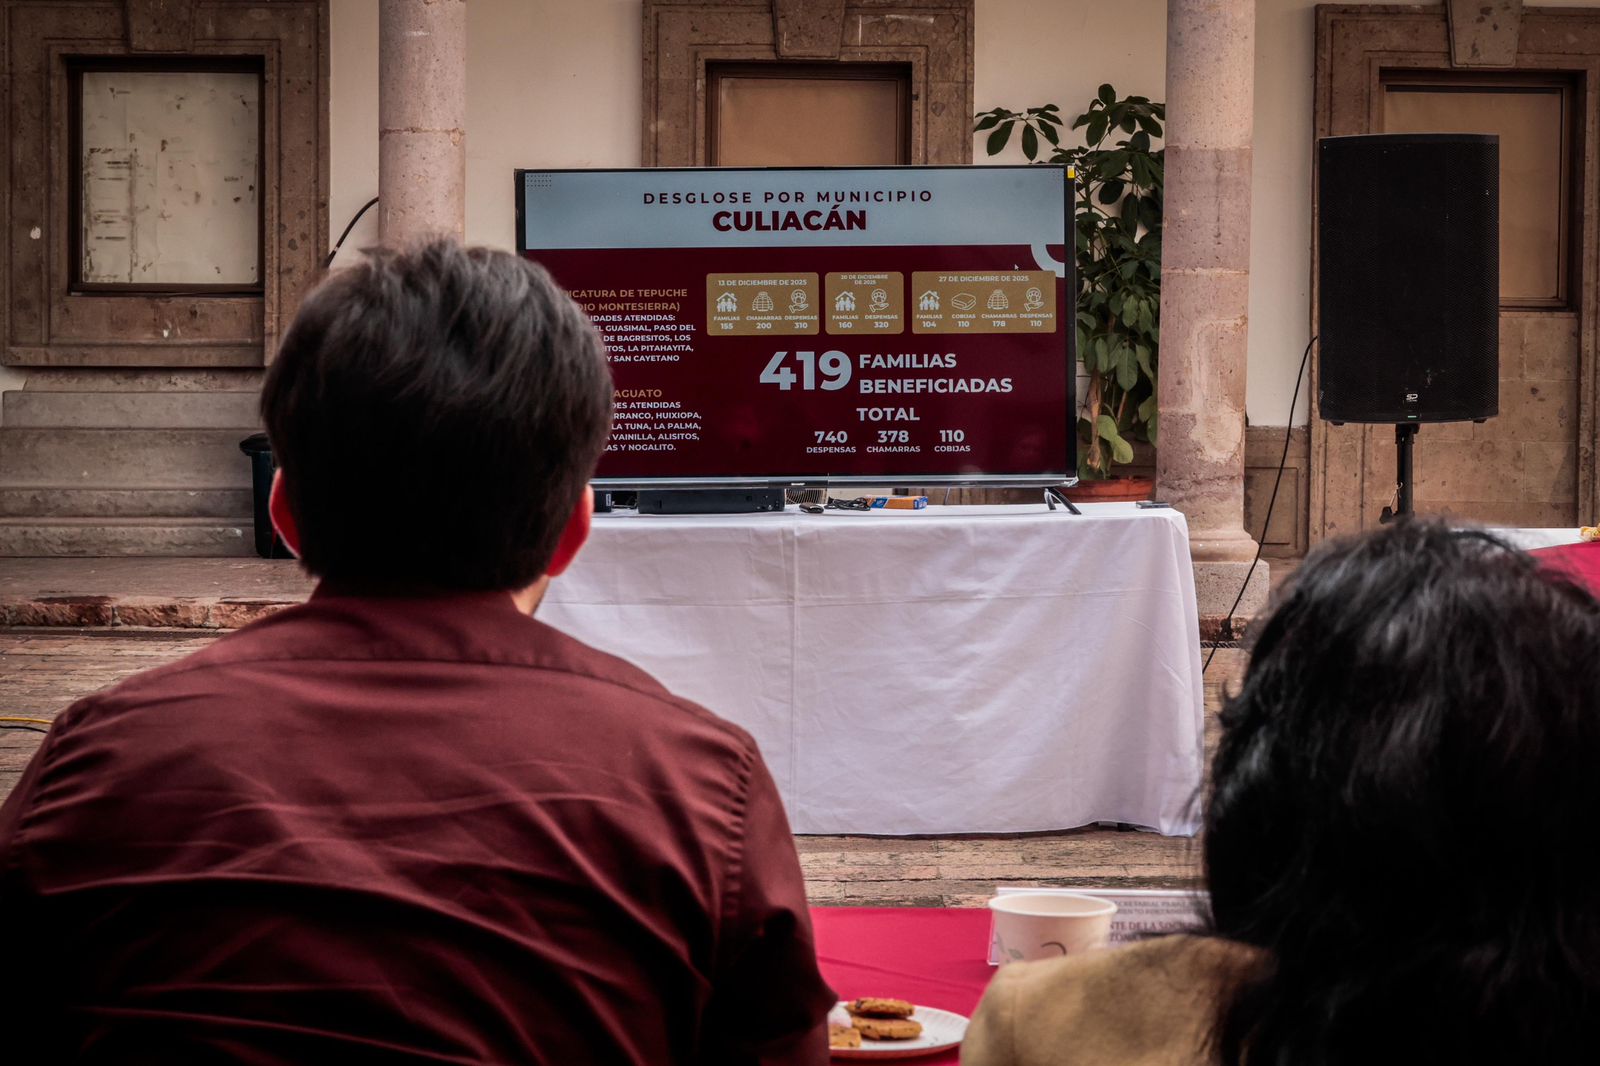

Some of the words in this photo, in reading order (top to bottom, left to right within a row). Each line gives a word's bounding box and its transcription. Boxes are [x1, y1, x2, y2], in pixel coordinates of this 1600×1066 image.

[643, 192, 753, 205] DESGLOSE
[764, 191, 806, 204] POR
[816, 189, 933, 204] MUNICIPIO
[712, 204, 867, 232] CULIACÁN
[620, 289, 635, 298] DE
[637, 289, 688, 298] TEPUCHE
[599, 302, 680, 312] MONTESIERRA)
[641, 344, 694, 352] PITAHAYITA,
[859, 353, 957, 368] FAMILIAS
[759, 350, 853, 392] 419
[859, 377, 1013, 394] BENEFICIADAS
[614, 412, 654, 420] RRANCO,
[656, 412, 702, 420] HUIXIOPA,
[857, 407, 920, 422] TOTAL
[668, 422, 702, 430] PALMA,
[814, 430, 848, 444] 740
[877, 430, 909, 443] 378
[939, 429, 965, 443] 110
[806, 446, 856, 454] DESPENSAS
[866, 445, 921, 453] CHAMARRAS
[934, 444, 971, 452] COBIJAS
